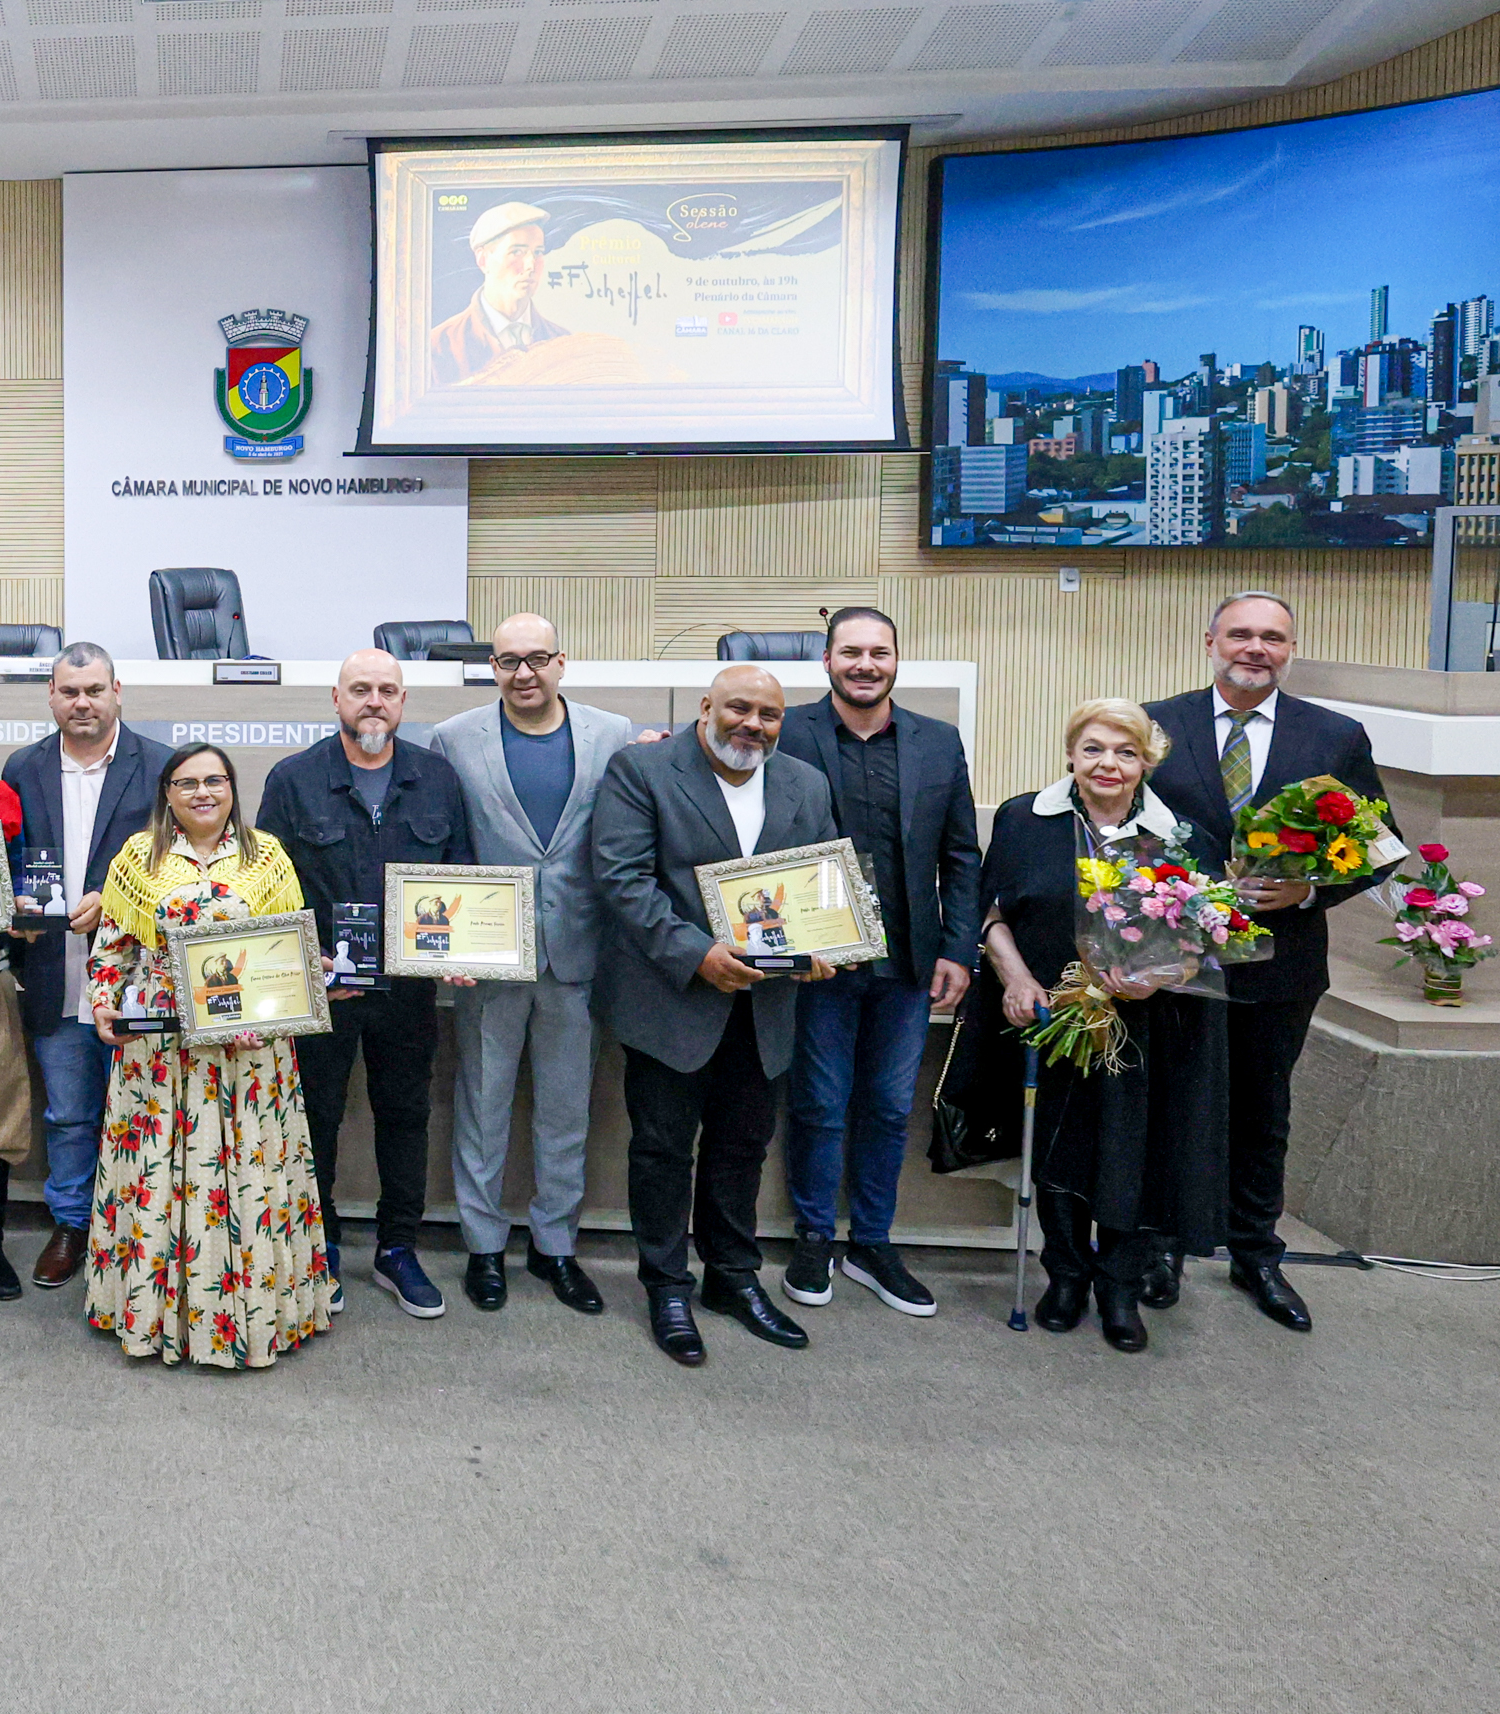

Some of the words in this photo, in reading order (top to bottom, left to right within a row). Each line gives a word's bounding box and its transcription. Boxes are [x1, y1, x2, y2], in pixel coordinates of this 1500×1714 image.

[680, 204, 738, 218] Sessão
[580, 236, 642, 251] Prêmio
[686, 277, 693, 286] 9
[695, 276, 709, 286] de
[711, 276, 760, 287] outubro,
[778, 275, 798, 286] 19h
[694, 292, 739, 302] Plenário
[741, 292, 754, 301] da
[757, 291, 797, 301] Câmara
[111, 476, 178, 497] CÂMARA
[182, 478, 258, 496] MUNICIPAL
[263, 479, 283, 495] DE
[288, 479, 332, 495] NOVO
[172, 723, 336, 744] PRESIDENTE
